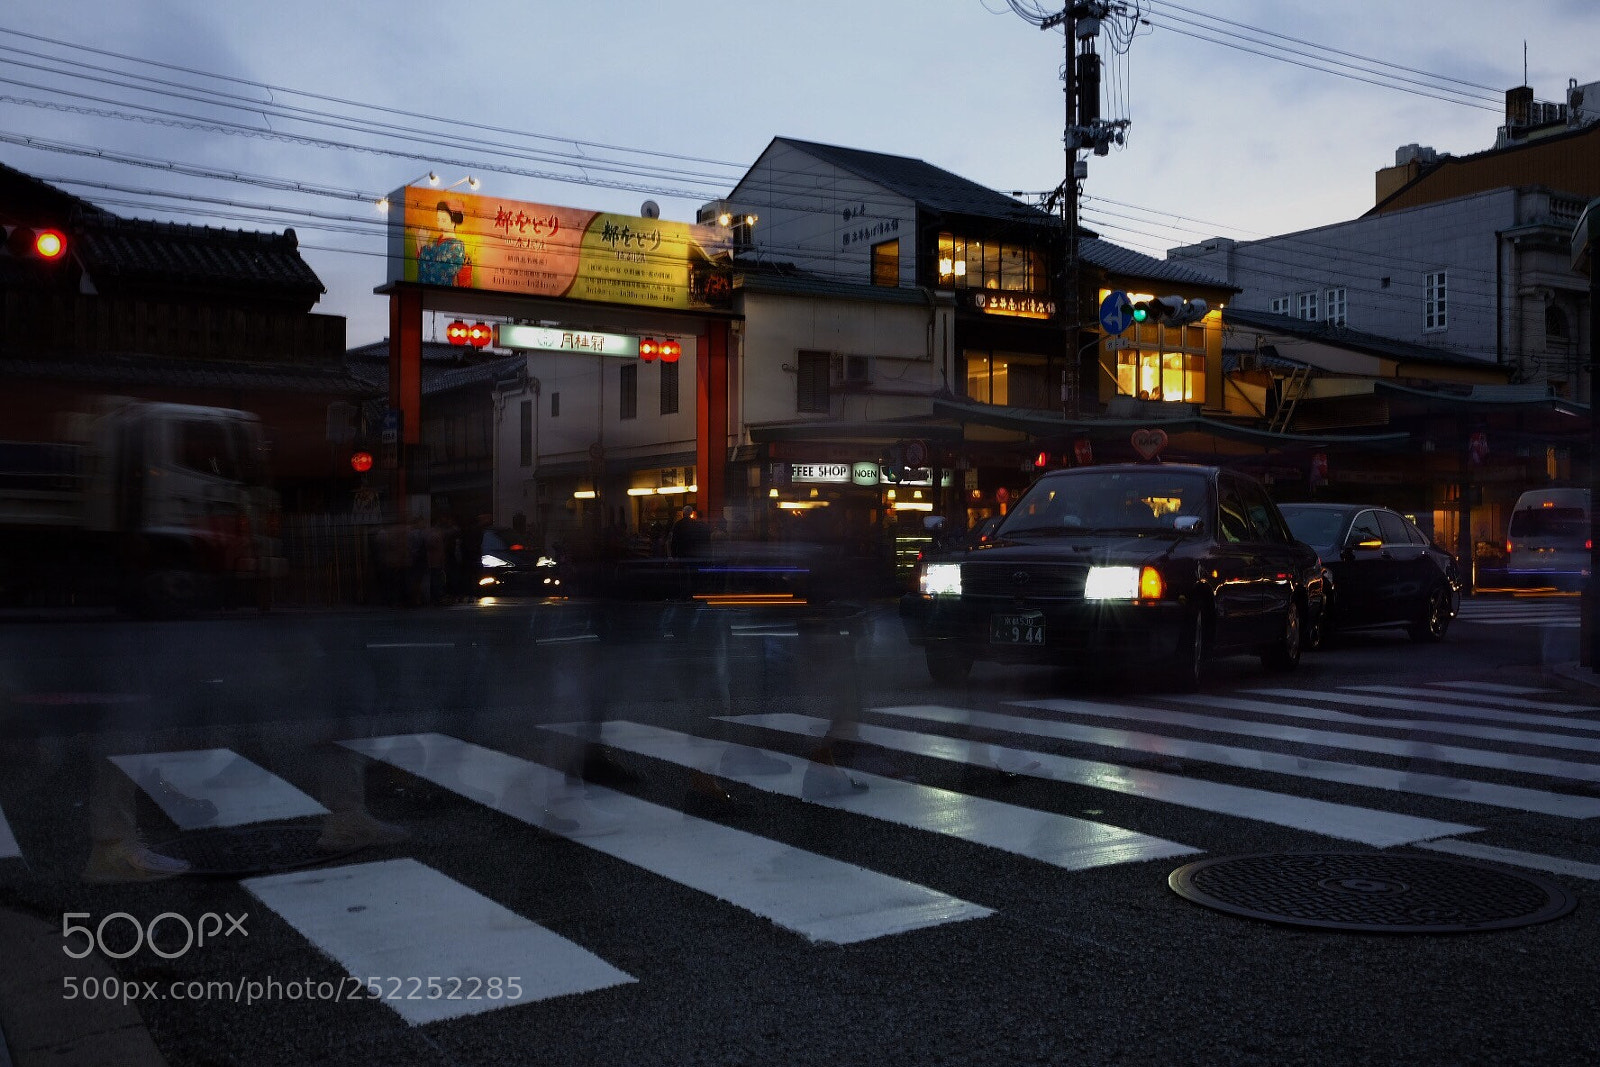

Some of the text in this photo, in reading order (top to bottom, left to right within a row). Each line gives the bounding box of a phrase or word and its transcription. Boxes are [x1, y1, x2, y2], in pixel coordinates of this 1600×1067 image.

[560, 332, 605, 351] 月桂冠
[818, 466, 846, 477] SHOP
[854, 469, 878, 478] NOEN
